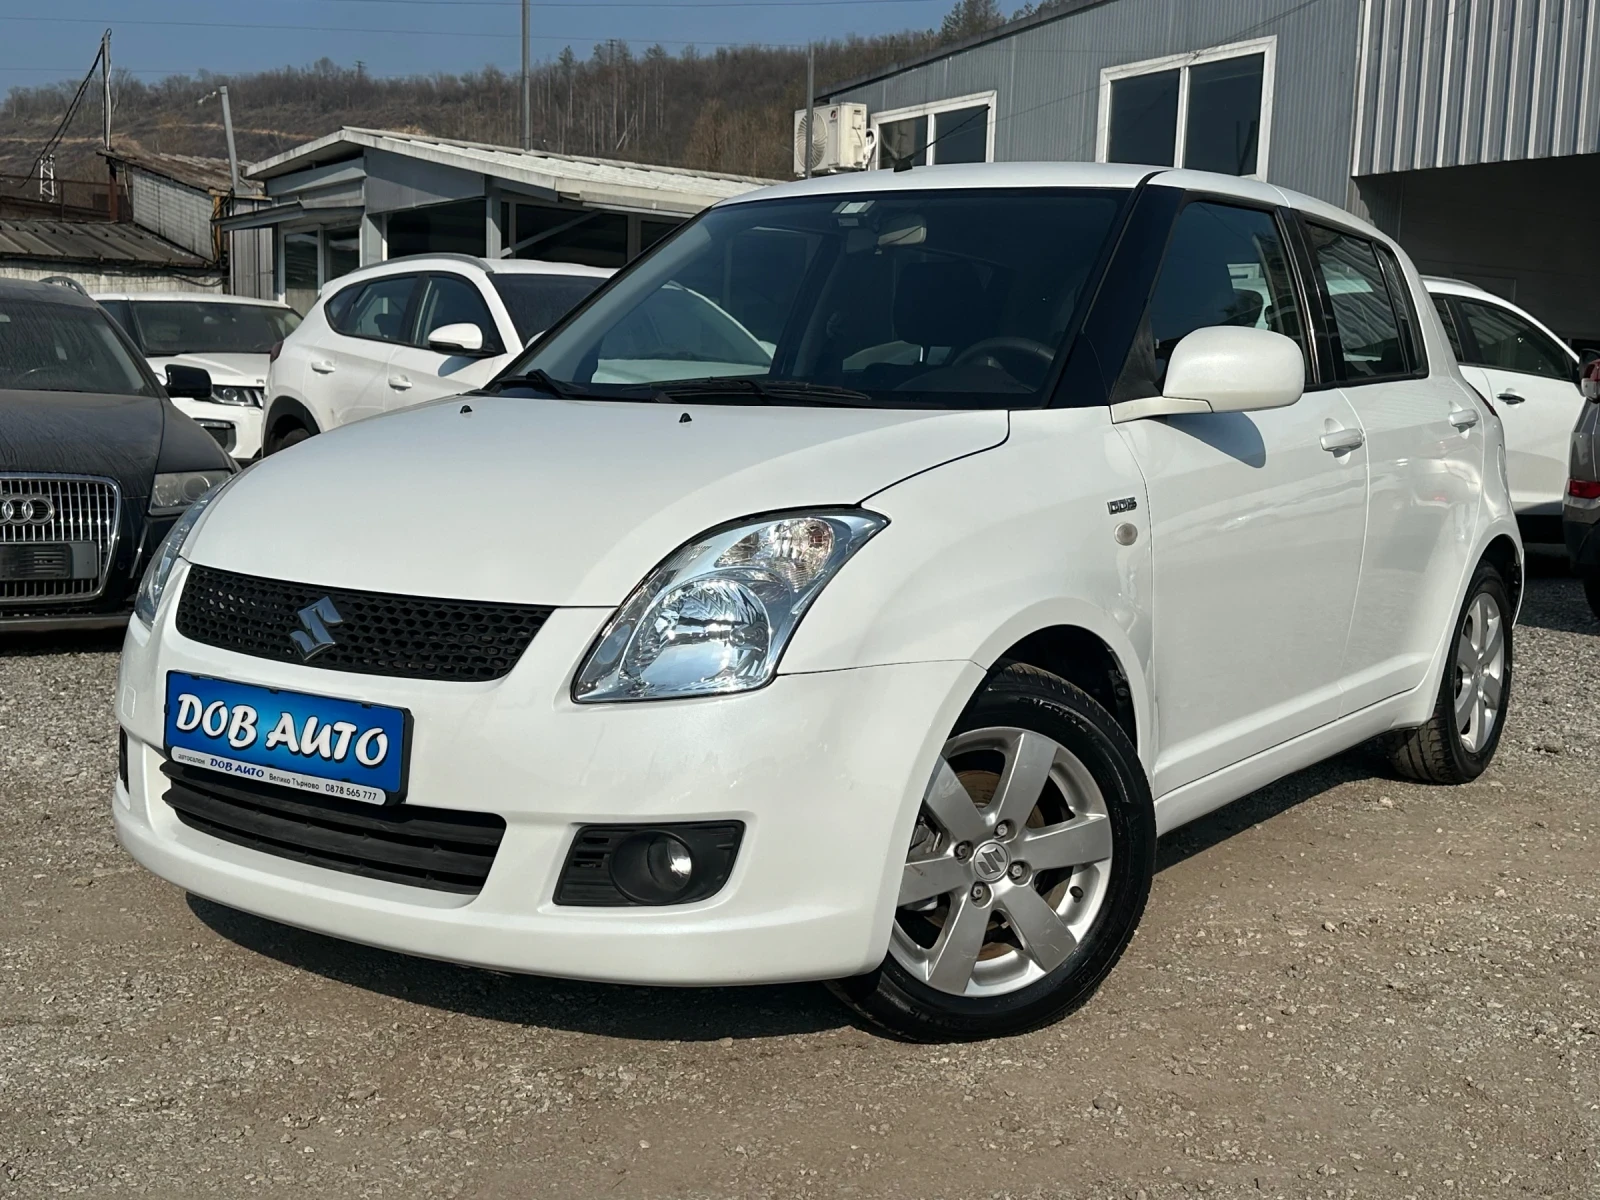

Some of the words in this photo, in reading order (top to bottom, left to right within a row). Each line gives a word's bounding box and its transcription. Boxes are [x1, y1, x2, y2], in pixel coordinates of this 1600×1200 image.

[176, 693, 258, 748] DOB
[265, 712, 389, 766] AUTO
[209, 758, 233, 772] DOB
[234, 764, 265, 778] AUTO
[269, 773, 291, 784] Велико
[291, 777, 320, 790] Търново
[325, 783, 345, 795] 0878
[346, 787, 361, 798] 565
[362, 790, 377, 801] 777
